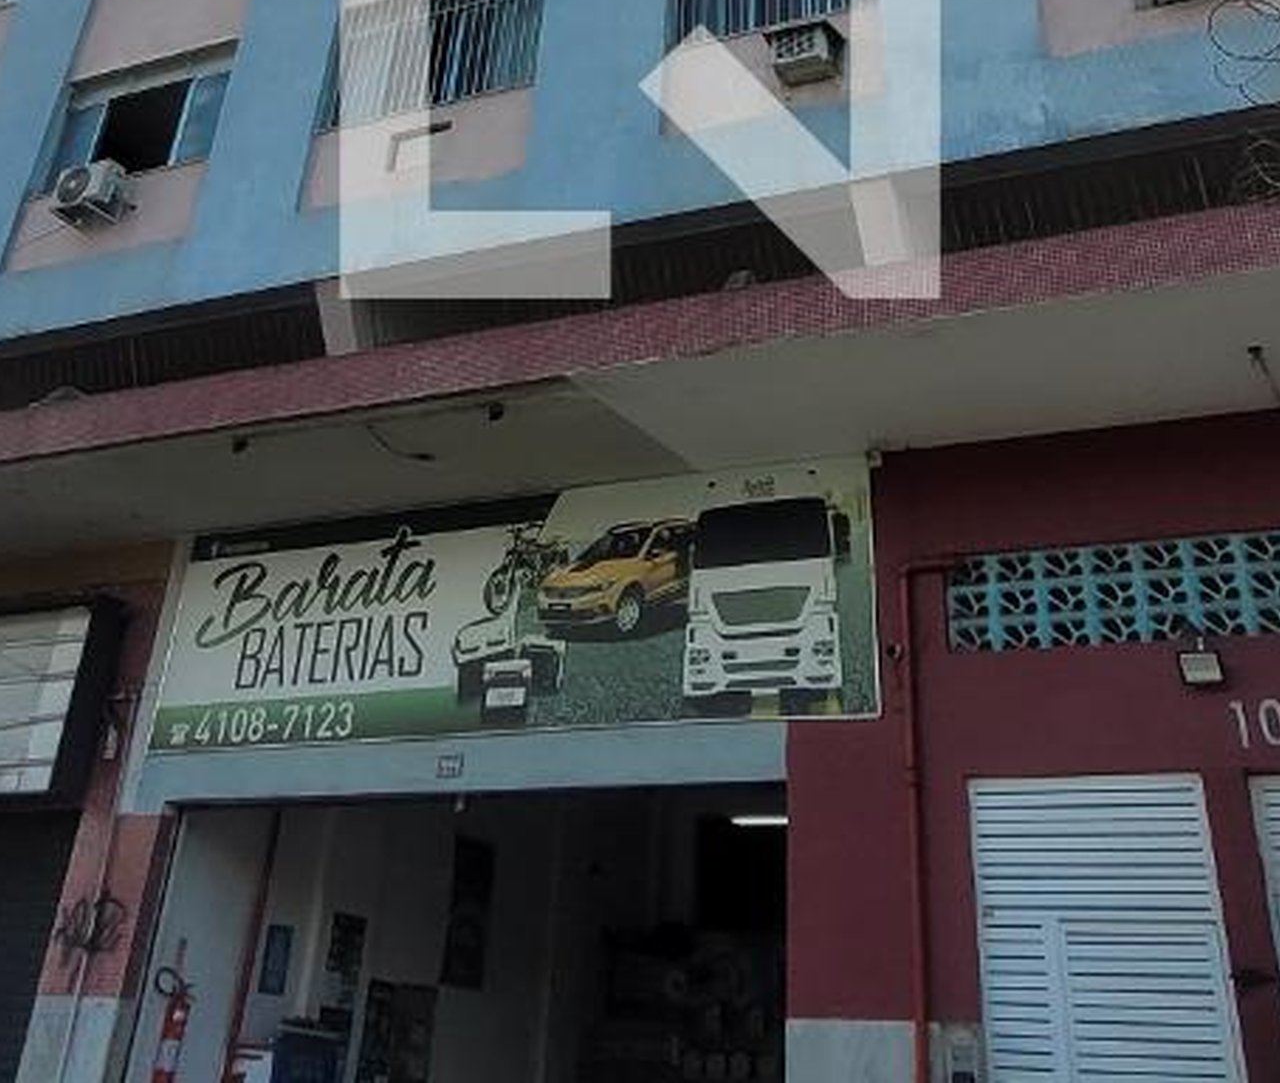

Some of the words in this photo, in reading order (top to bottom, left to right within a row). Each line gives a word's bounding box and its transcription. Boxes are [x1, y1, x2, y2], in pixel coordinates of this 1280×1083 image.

[195, 527, 437, 648] Barata
[234, 612, 428, 690] BATERIAS
[194, 701, 356, 745] 4108-7123
